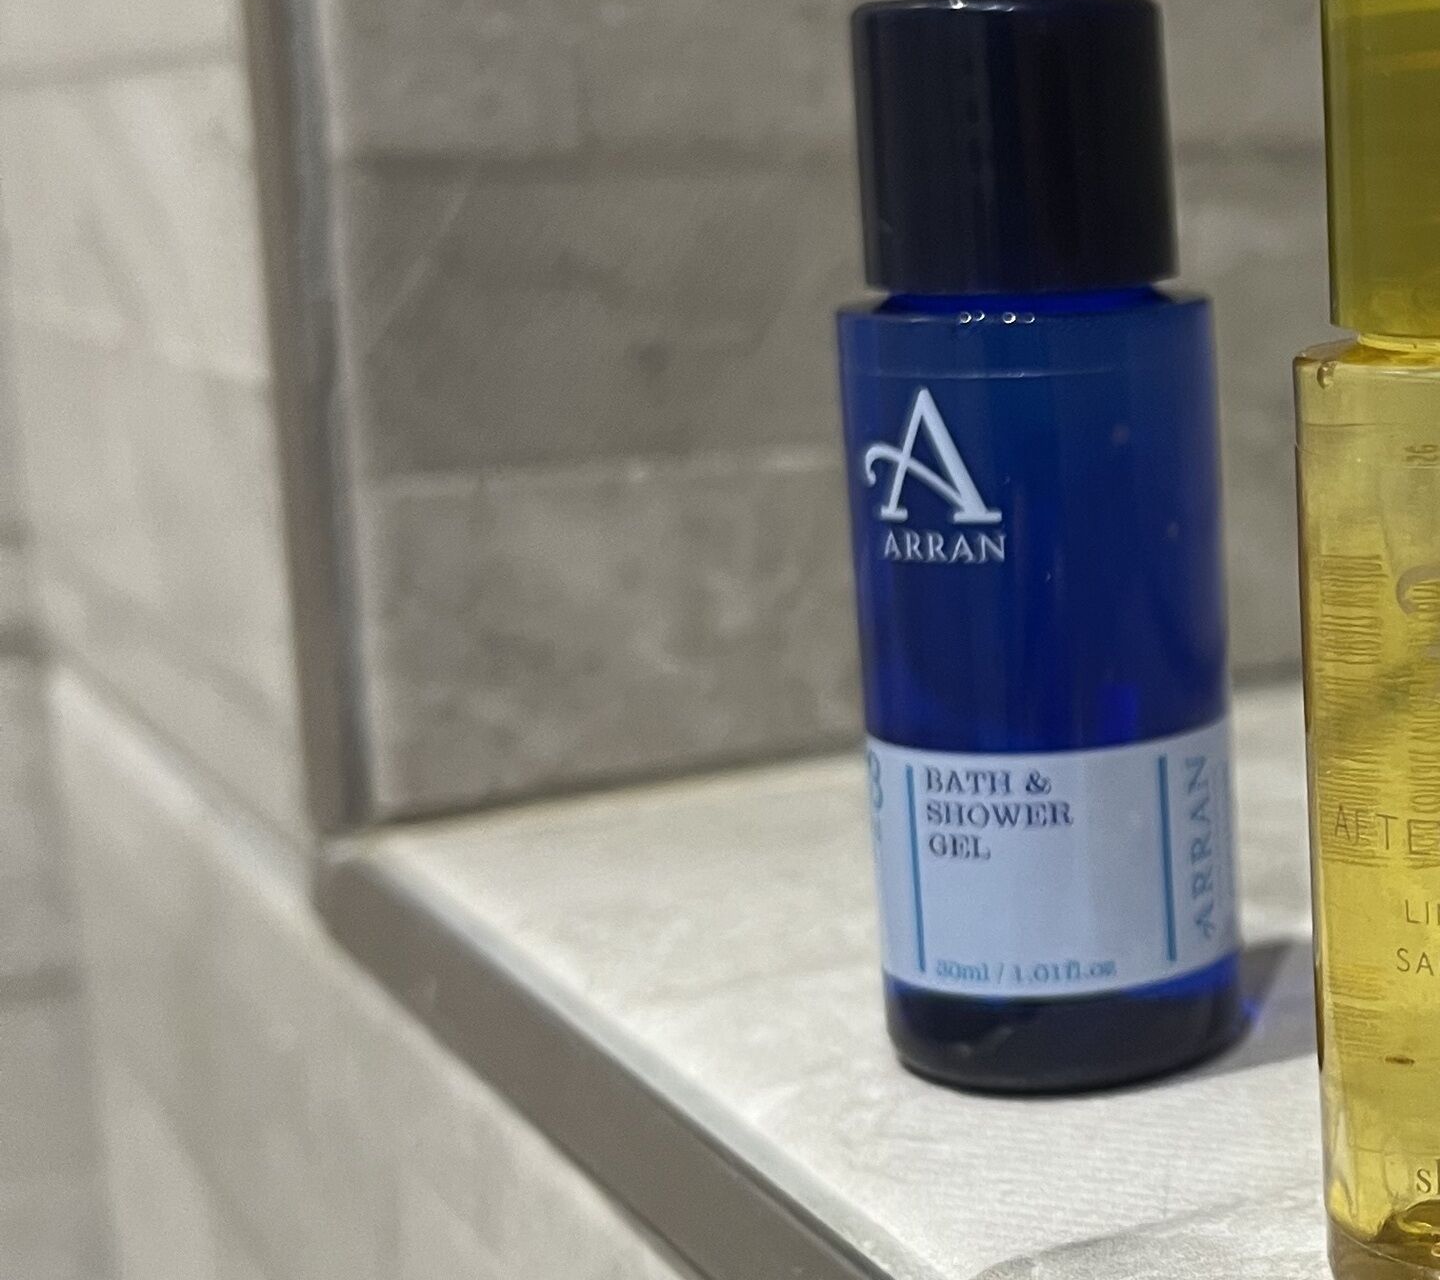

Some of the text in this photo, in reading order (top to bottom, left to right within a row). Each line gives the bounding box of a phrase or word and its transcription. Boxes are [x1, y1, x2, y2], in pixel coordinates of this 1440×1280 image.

[864, 387, 1002, 523] A
[884, 528, 1006, 564] ARRAN
[926, 766, 1052, 794] BATH &
[926, 799, 1074, 828] SHOWER
[928, 833, 991, 860] GEL
[1185, 755, 1216, 939] ARRAN
